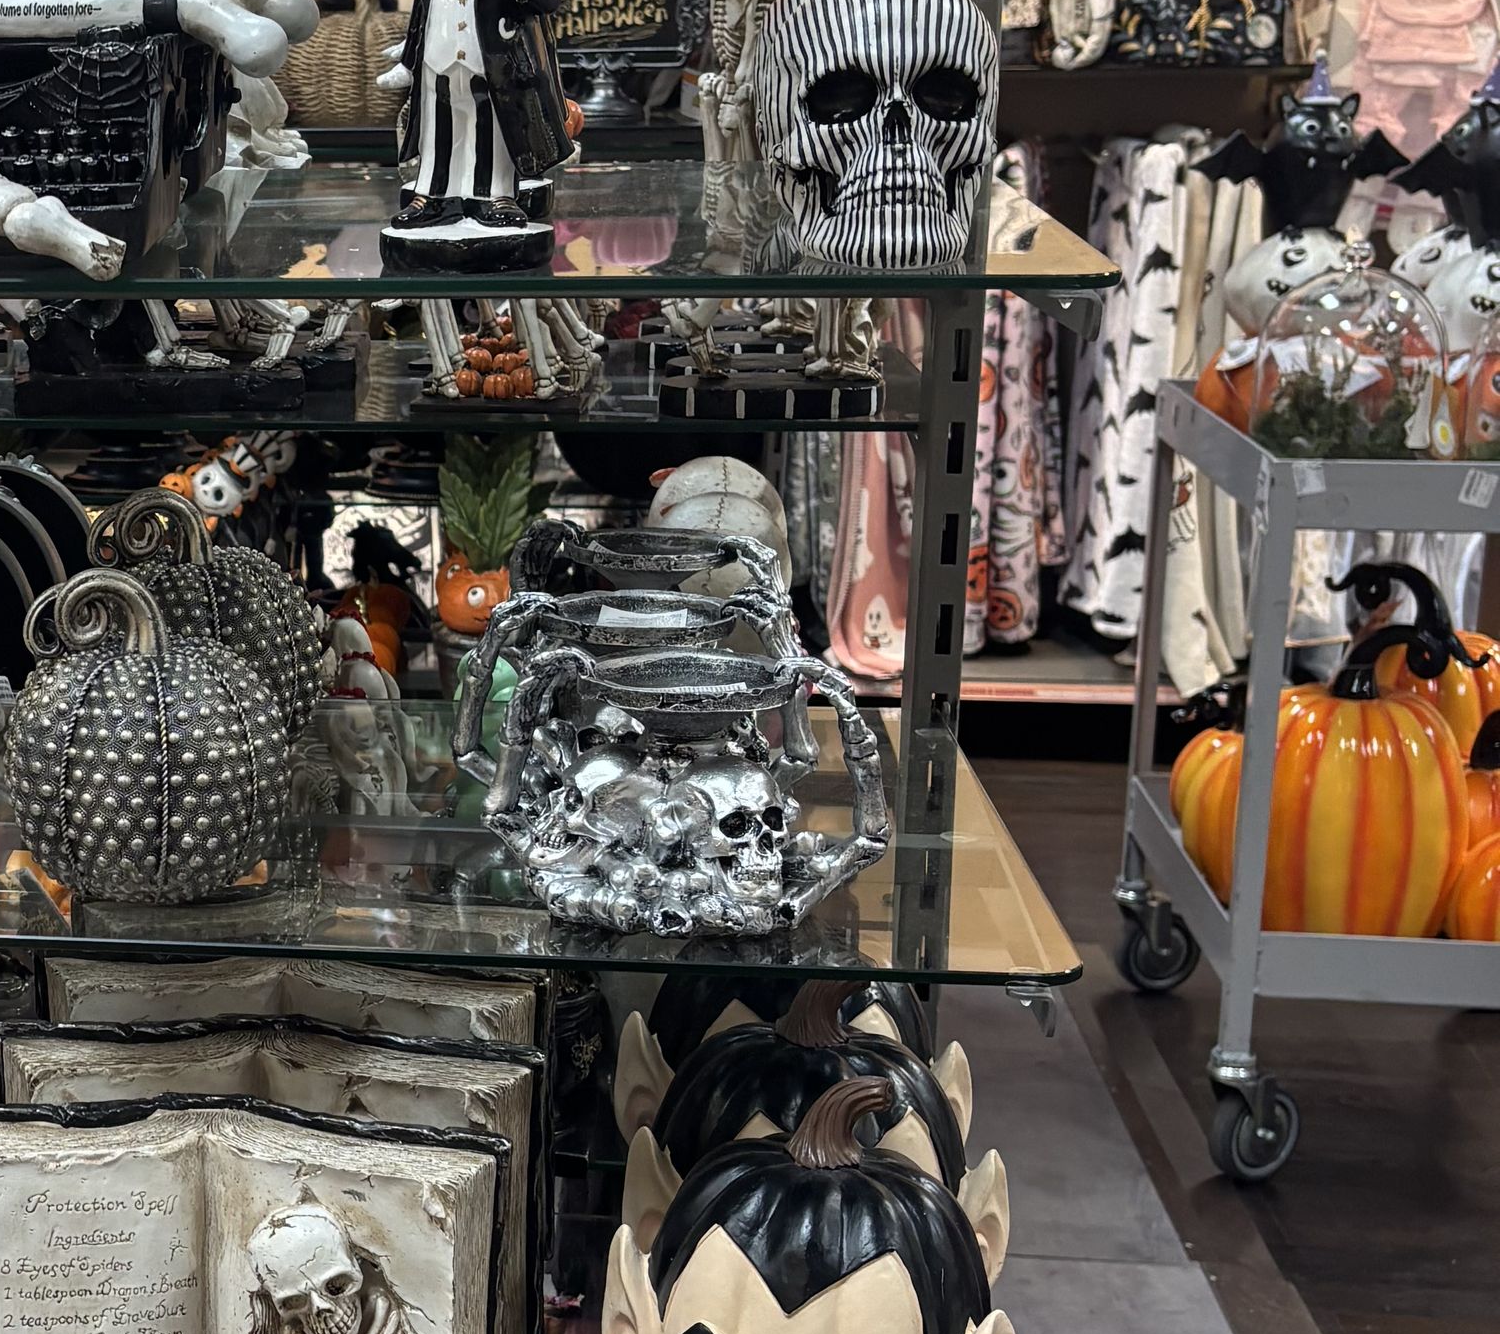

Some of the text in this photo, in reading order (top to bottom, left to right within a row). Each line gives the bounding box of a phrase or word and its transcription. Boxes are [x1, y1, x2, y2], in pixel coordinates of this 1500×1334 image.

[22, 3, 33, 17] of
[33, 3, 74, 18] forgotten
[555, 3, 669, 38] Halloween
[25, 1189, 179, 1217] Protection Spell
[46, 1227, 136, 1250] Ingredients
[0, 1256, 134, 1281] 8 Eyes of Spiders
[18, 1285, 94, 1303] tablespoon
[95, 1273, 156, 1302] Dragon's
[157, 1272, 199, 1294] Breath
[3, 1298, 188, 1331] 2 teaspoons of Grave Dust
